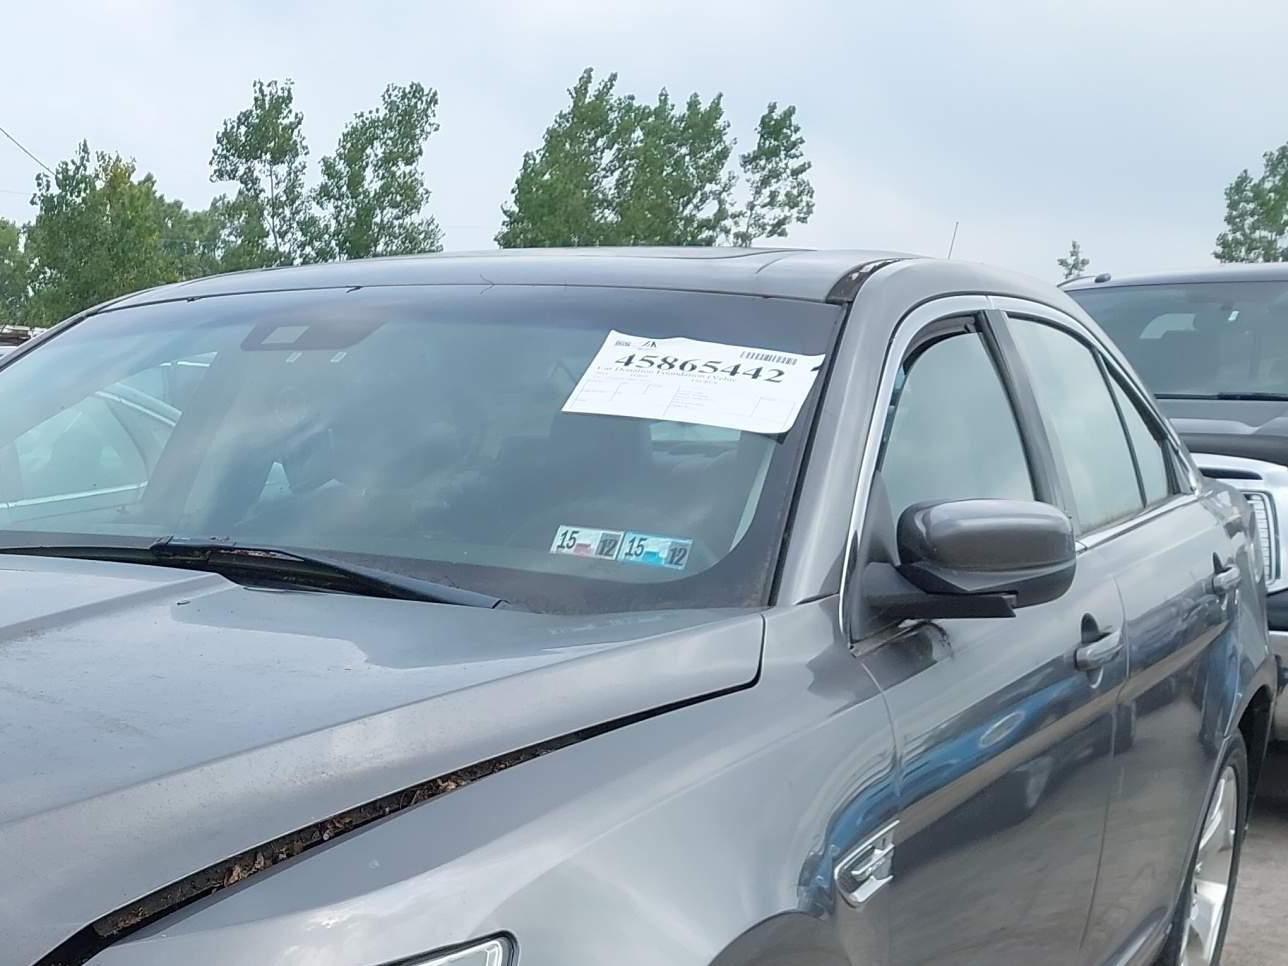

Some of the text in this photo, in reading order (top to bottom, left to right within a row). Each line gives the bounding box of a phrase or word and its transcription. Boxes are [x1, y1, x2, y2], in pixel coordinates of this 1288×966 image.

[615, 353, 786, 384] 45865442
[557, 530, 619, 557] 15 12
[624, 536, 688, 566] 15 12
